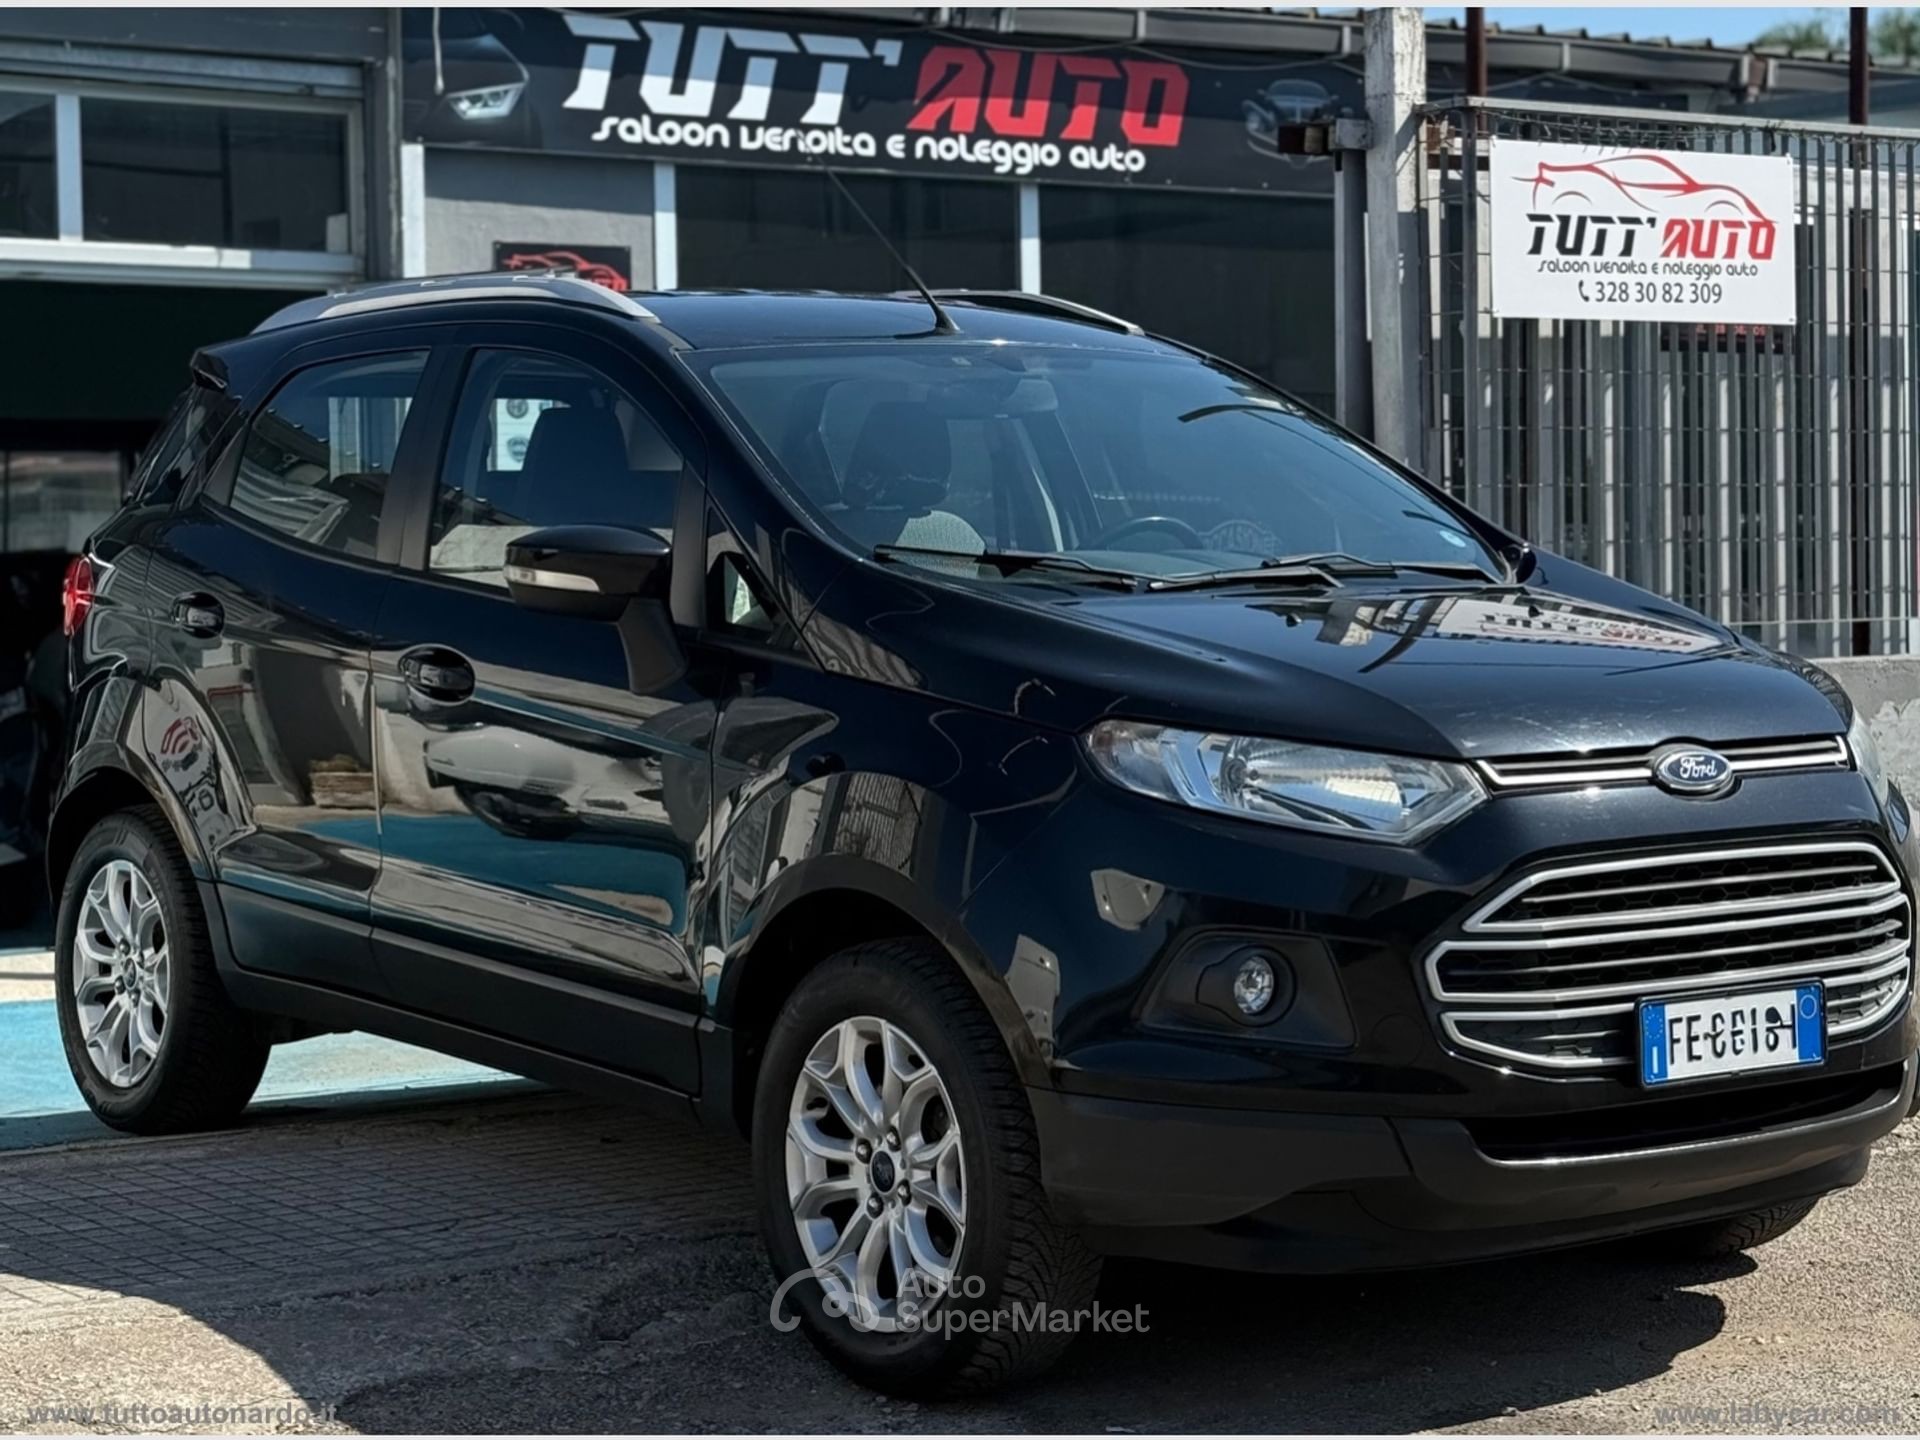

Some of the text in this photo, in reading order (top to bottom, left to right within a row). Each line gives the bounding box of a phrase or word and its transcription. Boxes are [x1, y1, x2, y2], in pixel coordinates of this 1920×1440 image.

[562, 14, 1190, 147] TUTT' AUTO
[915, 133, 1061, 175] noleggio
[1069, 142, 1146, 172] auto
[1526, 213, 1776, 260] TUTT' AUTO
[1663, 262, 1722, 280] noleggio
[1726, 262, 1758, 276] auto
[1595, 281, 1722, 304] 328 30 82 309
[1680, 756, 1718, 779] Ford
